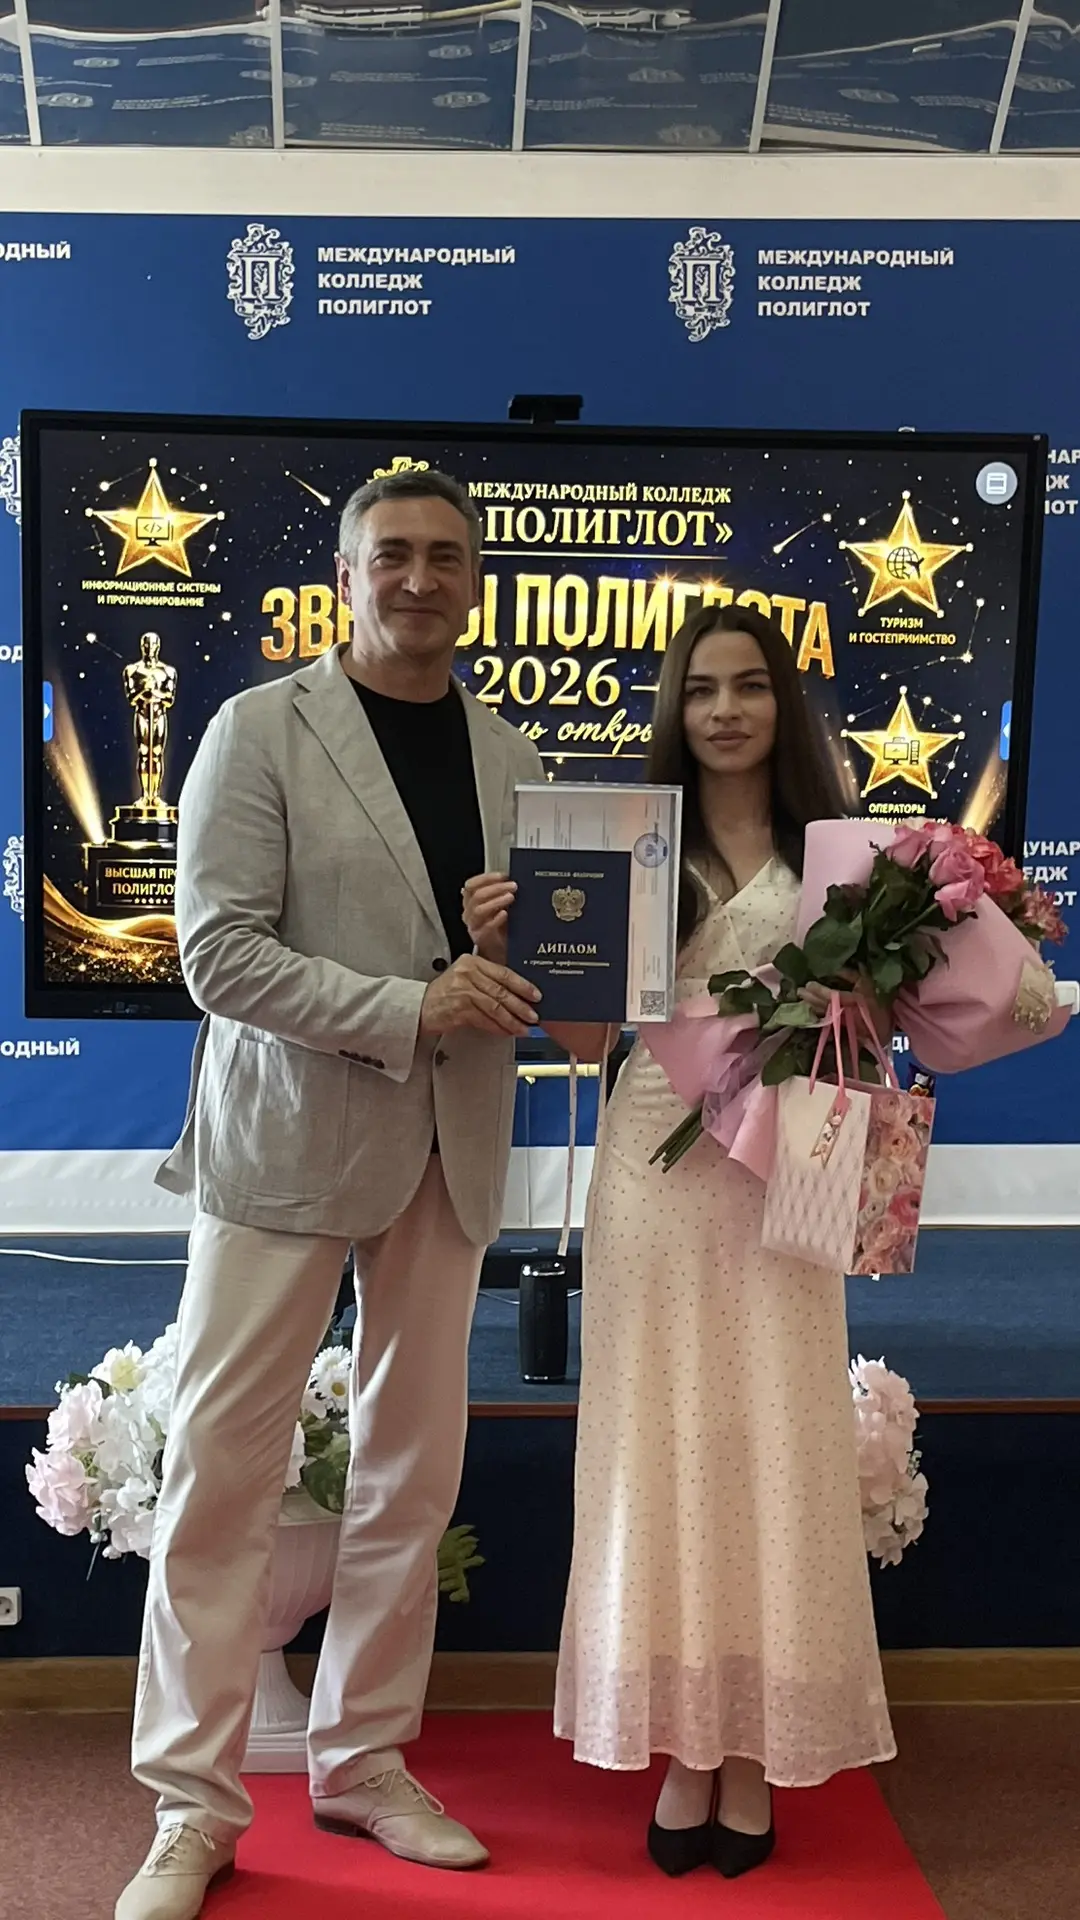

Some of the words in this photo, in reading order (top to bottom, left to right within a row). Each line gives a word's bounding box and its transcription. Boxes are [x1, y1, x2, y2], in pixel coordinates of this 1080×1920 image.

[317, 245, 516, 266] МЕЖДУНАРОДНЫЙ
[757, 247, 954, 267] МЕЖДУНАРОДНЫЙ
[317, 273, 423, 291] КОЛЛЕДЖ
[757, 275, 862, 292] КОЛЛЕДЖ
[317, 299, 432, 315] ПОЛИГЛОТ
[757, 301, 871, 317] ПОЛИГЛОТ
[467, 481, 638, 502] МЕЖДУНАРОДНЫЙ
[641, 486, 732, 505] КОЛЛЕДЖ
[479, 505, 733, 547] ПОЛИГЛОТ»
[82, 580, 175, 592] ИНФОРМАЦИОННЫЕ
[176, 582, 222, 593] СИСТЕМЫ
[97, 595, 105, 604] И
[106, 595, 204, 607] ПРОГРАММИРОВАНИЕ
[514, 573, 835, 679] ПОЛИГТА
[880, 617, 924, 629] ТУРИЗМ
[849, 632, 857, 643] И
[859, 632, 957, 645] ГОСТЕПРИИМСТВО
[473, 655, 621, 707] 2026
[868, 803, 926, 814] ОПЕРАТОРЫ
[104, 867, 156, 879] ВЫСШАЯ
[112, 883, 176, 896] ПОЛИГЛО
[536, 943, 598, 955] ДИПЛОМ
